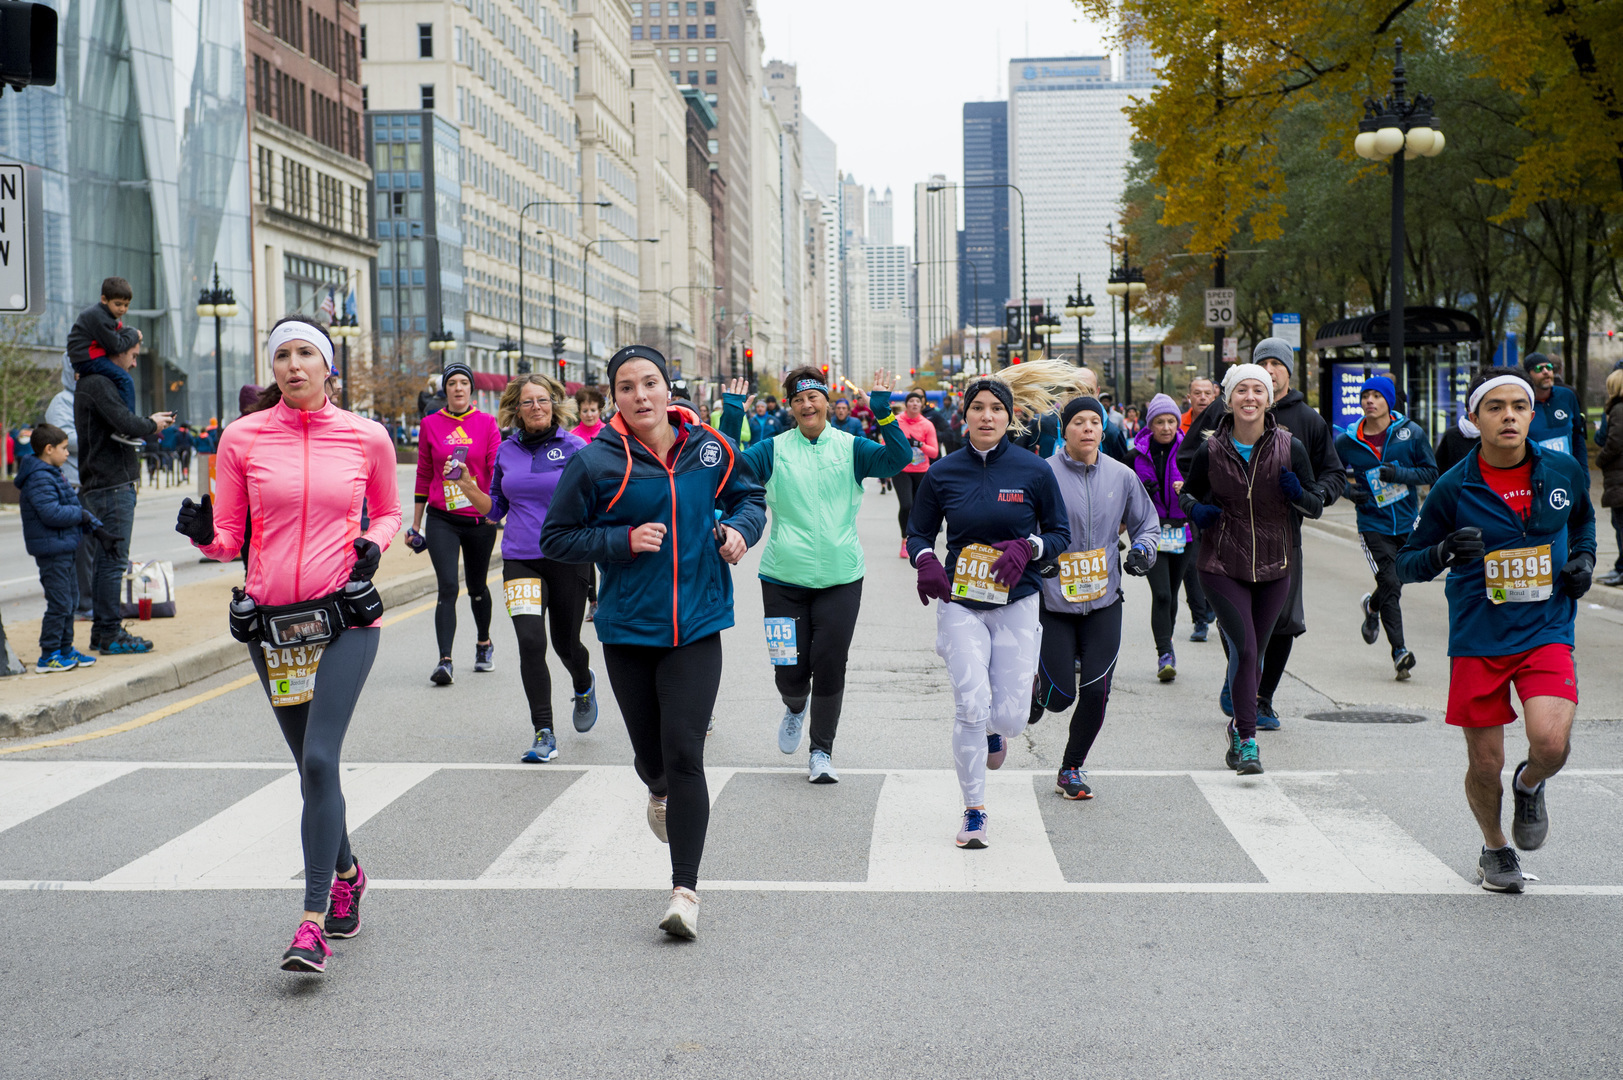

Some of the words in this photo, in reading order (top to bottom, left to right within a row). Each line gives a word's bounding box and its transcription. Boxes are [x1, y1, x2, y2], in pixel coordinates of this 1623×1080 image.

[1207, 291, 1233, 299] SPEED
[1209, 307, 1232, 322] 30
[1342, 372, 1366, 384] Strai
[1341, 394, 1360, 405] whi
[443, 437, 473, 445] adidas
[444, 483, 465, 498] 512
[1503, 489, 1532, 500] CHICA
[997, 492, 1024, 503] ALUMNI
[1060, 555, 1107, 577] 51941
[1486, 554, 1551, 579] 61395
[958, 585, 966, 594] F
[1514, 580, 1528, 588] 15K
[1068, 585, 1075, 595] F
[1494, 590, 1504, 600] A
[279, 681, 287, 693] C
